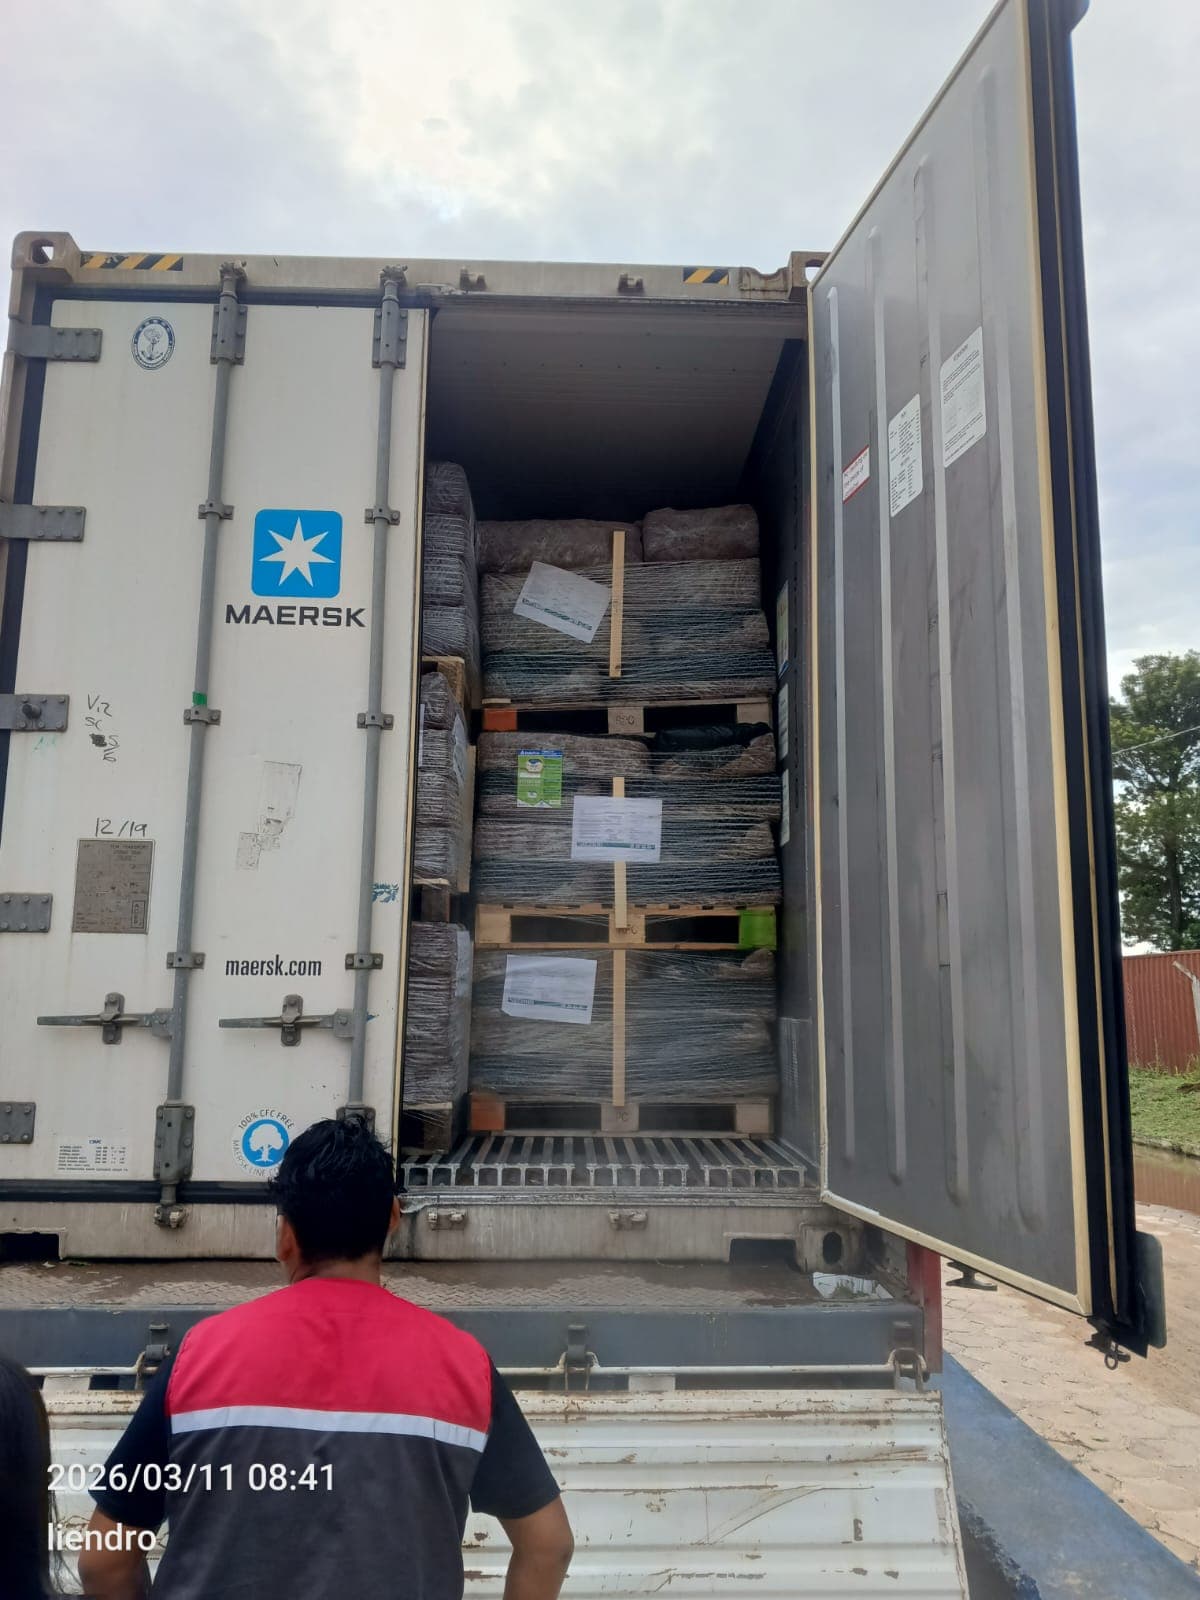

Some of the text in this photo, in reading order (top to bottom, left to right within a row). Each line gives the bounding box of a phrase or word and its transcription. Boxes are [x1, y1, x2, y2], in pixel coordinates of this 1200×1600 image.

[225, 604, 367, 628] MAERSK
[225, 953, 323, 977] maersk.com
[237, 1108, 296, 1130] 100% CFC FREE
